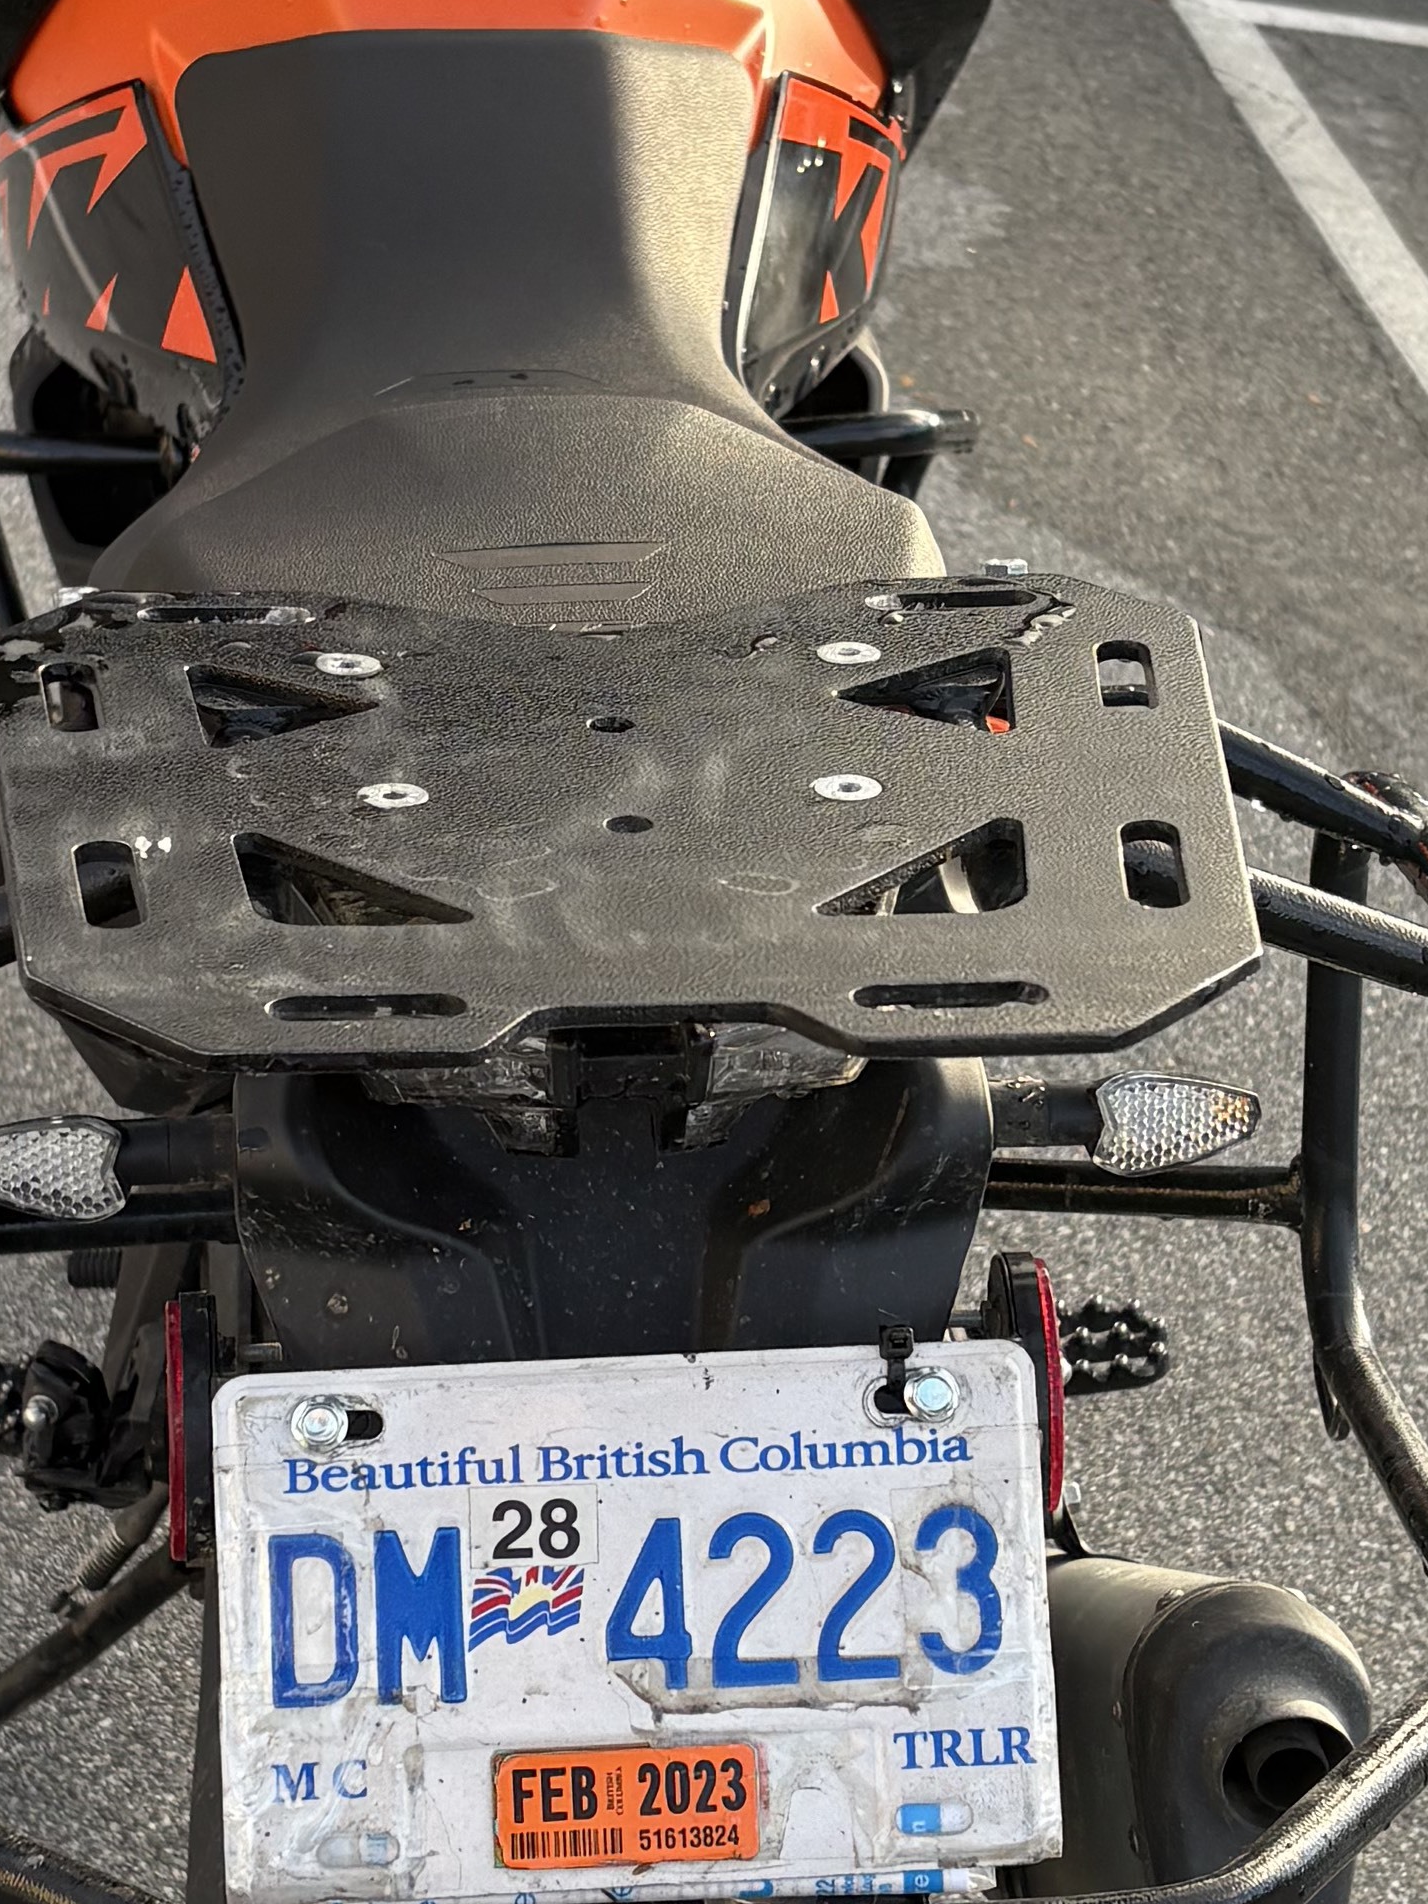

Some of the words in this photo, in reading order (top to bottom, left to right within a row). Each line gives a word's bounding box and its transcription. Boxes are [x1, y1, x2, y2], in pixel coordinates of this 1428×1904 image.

[283, 1443, 524, 1495] Beautiful
[537, 1435, 711, 1483] British
[719, 1426, 974, 1474] Columbia
[491, 1497, 582, 1560] 28
[267, 1526, 468, 1709] DM
[605, 1504, 1004, 1691] 4223
[892, 1725, 1038, 1771] TRLR
[510, 1765, 599, 1824] FEB
[637, 1757, 748, 1817] 2023
[638, 1823, 741, 1851] 51613824
